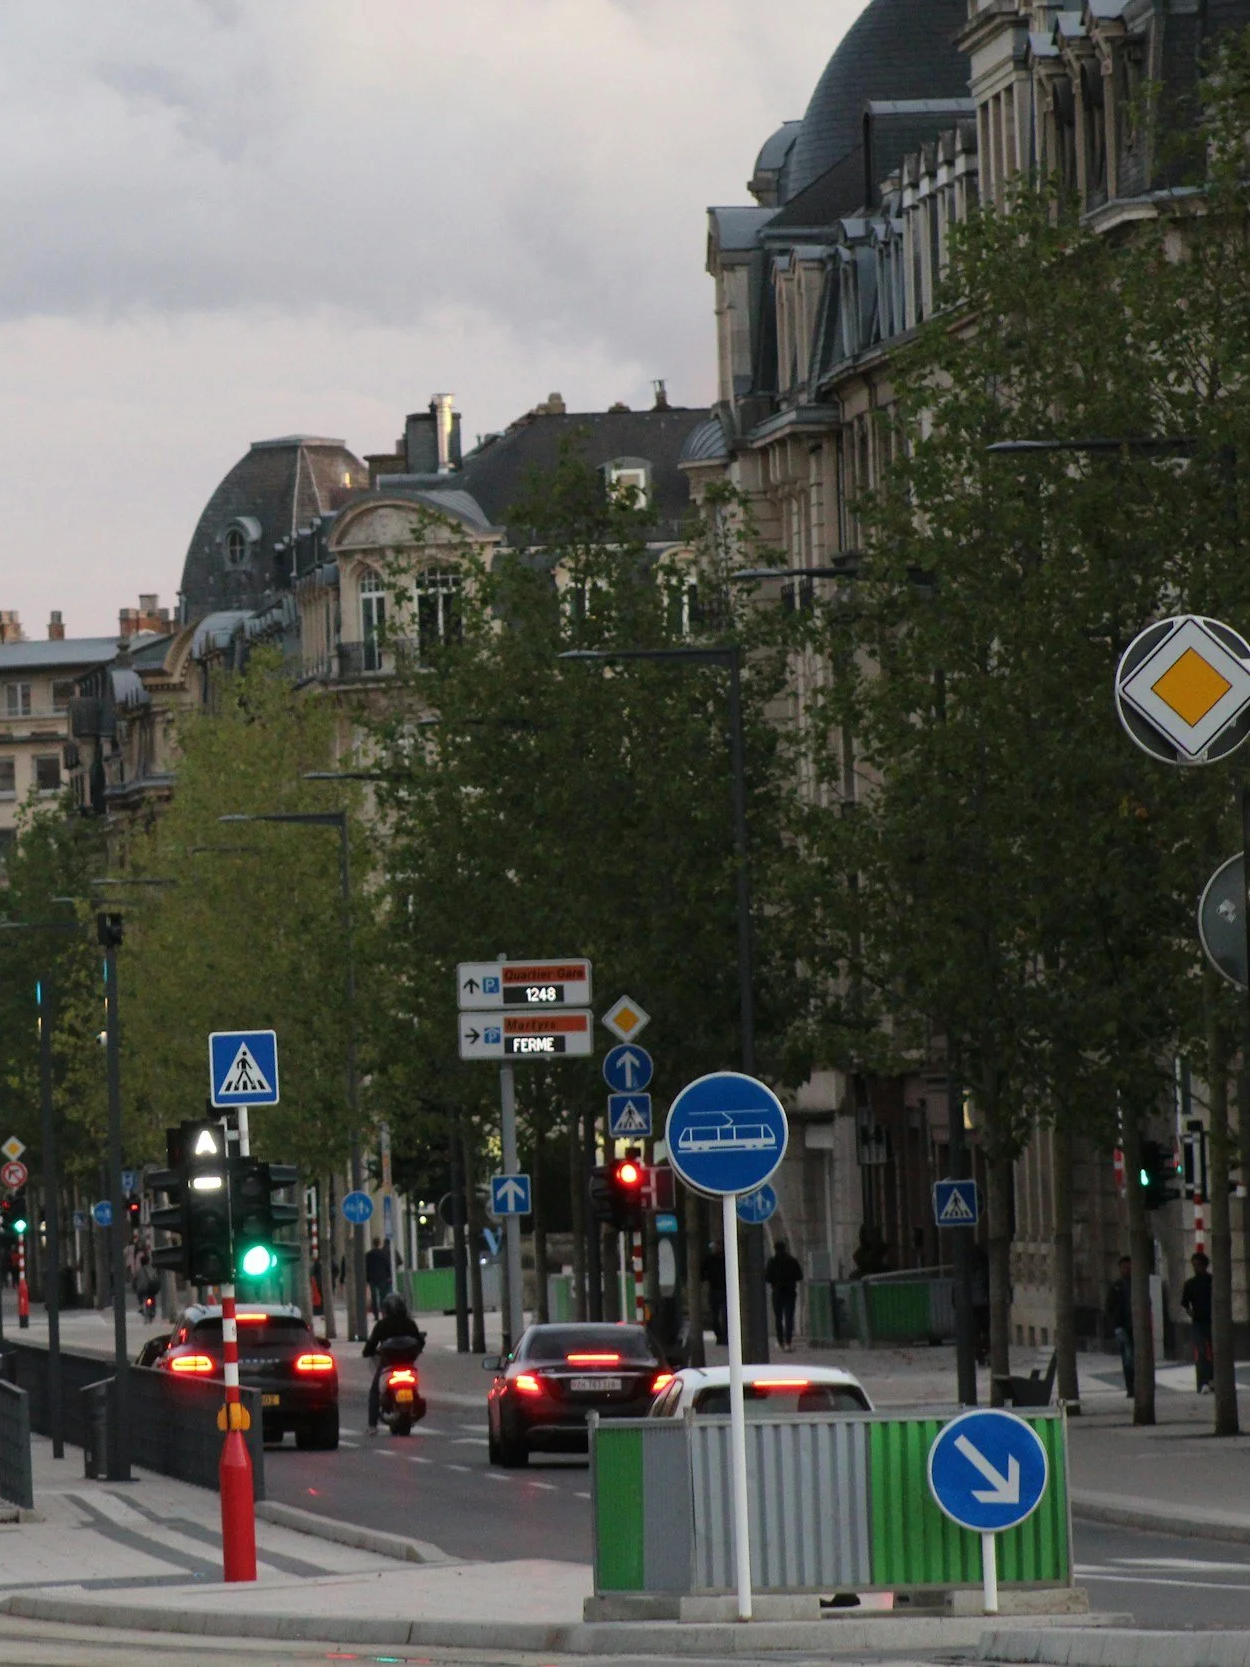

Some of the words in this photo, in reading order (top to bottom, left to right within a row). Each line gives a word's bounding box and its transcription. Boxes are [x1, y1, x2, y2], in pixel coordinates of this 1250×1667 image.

[504, 968, 550, 980] Quartier
[557, 967, 583, 979] Gare
[526, 987, 556, 1002] 1248
[513, 1037, 554, 1053] FERME
